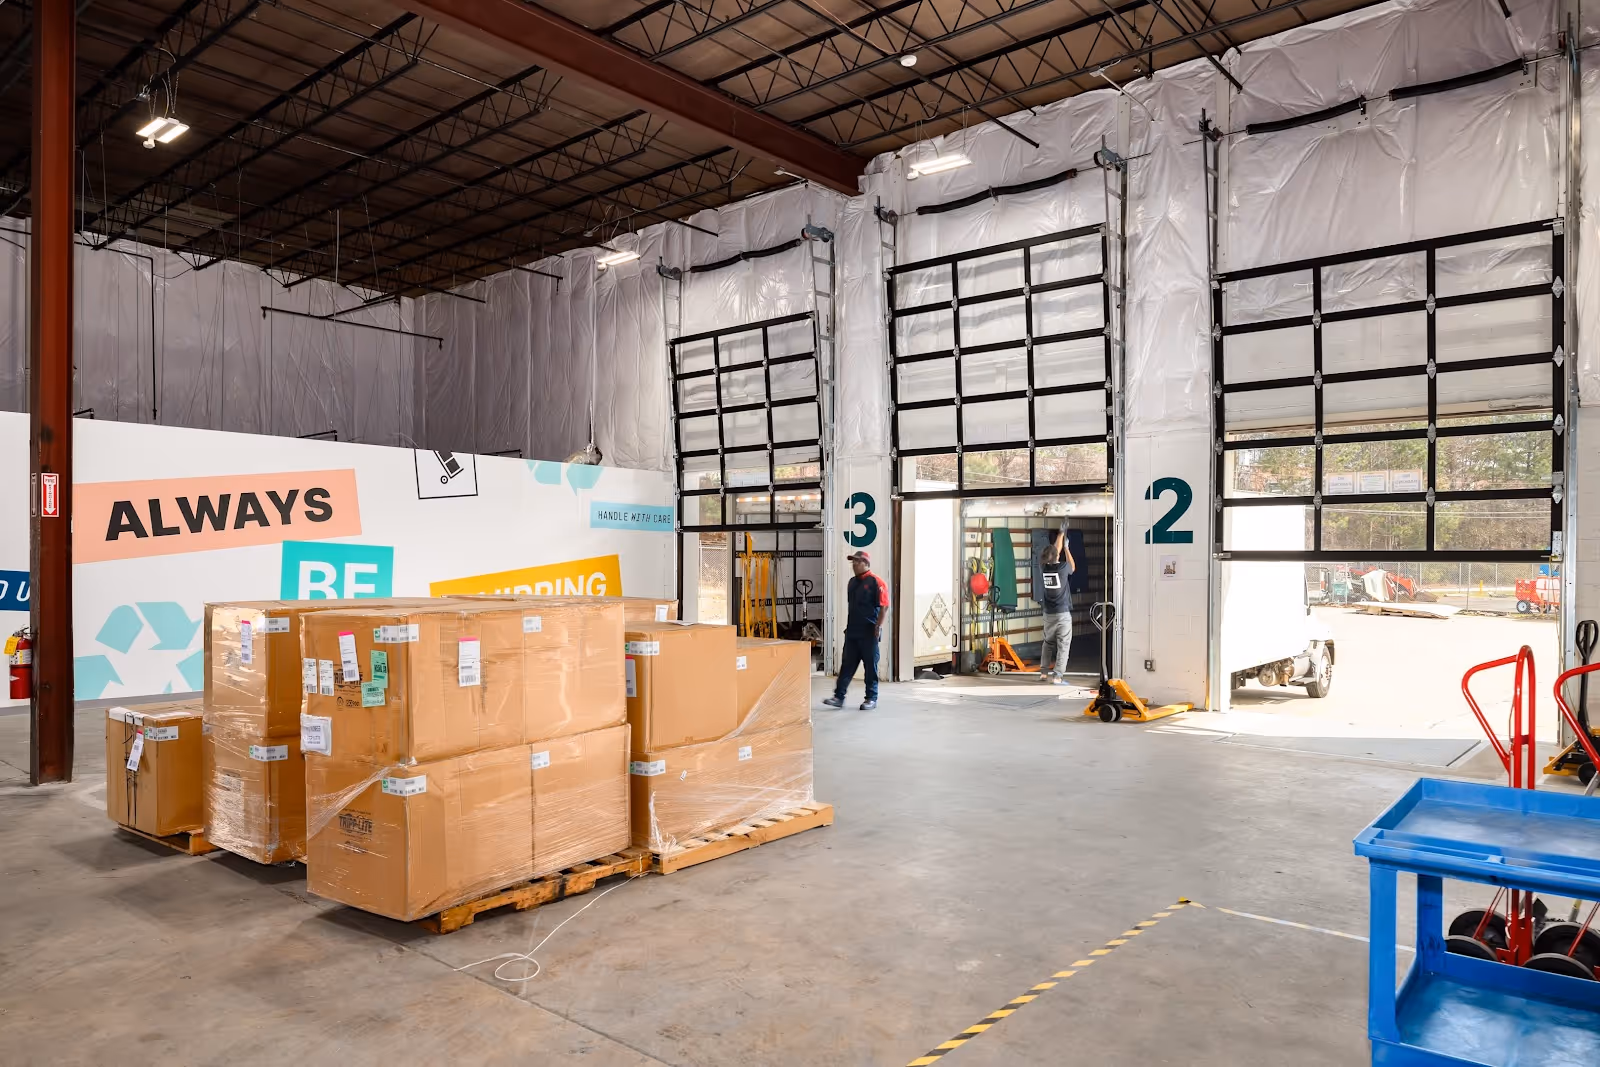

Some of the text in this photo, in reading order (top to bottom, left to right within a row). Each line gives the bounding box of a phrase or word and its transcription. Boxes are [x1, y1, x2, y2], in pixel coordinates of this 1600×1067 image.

[105, 487, 333, 541] ALWAYS
[598, 510, 671, 524] HANDLE WITH CARE
[843, 491, 878, 547] 3
[1144, 477, 1193, 544] 2
